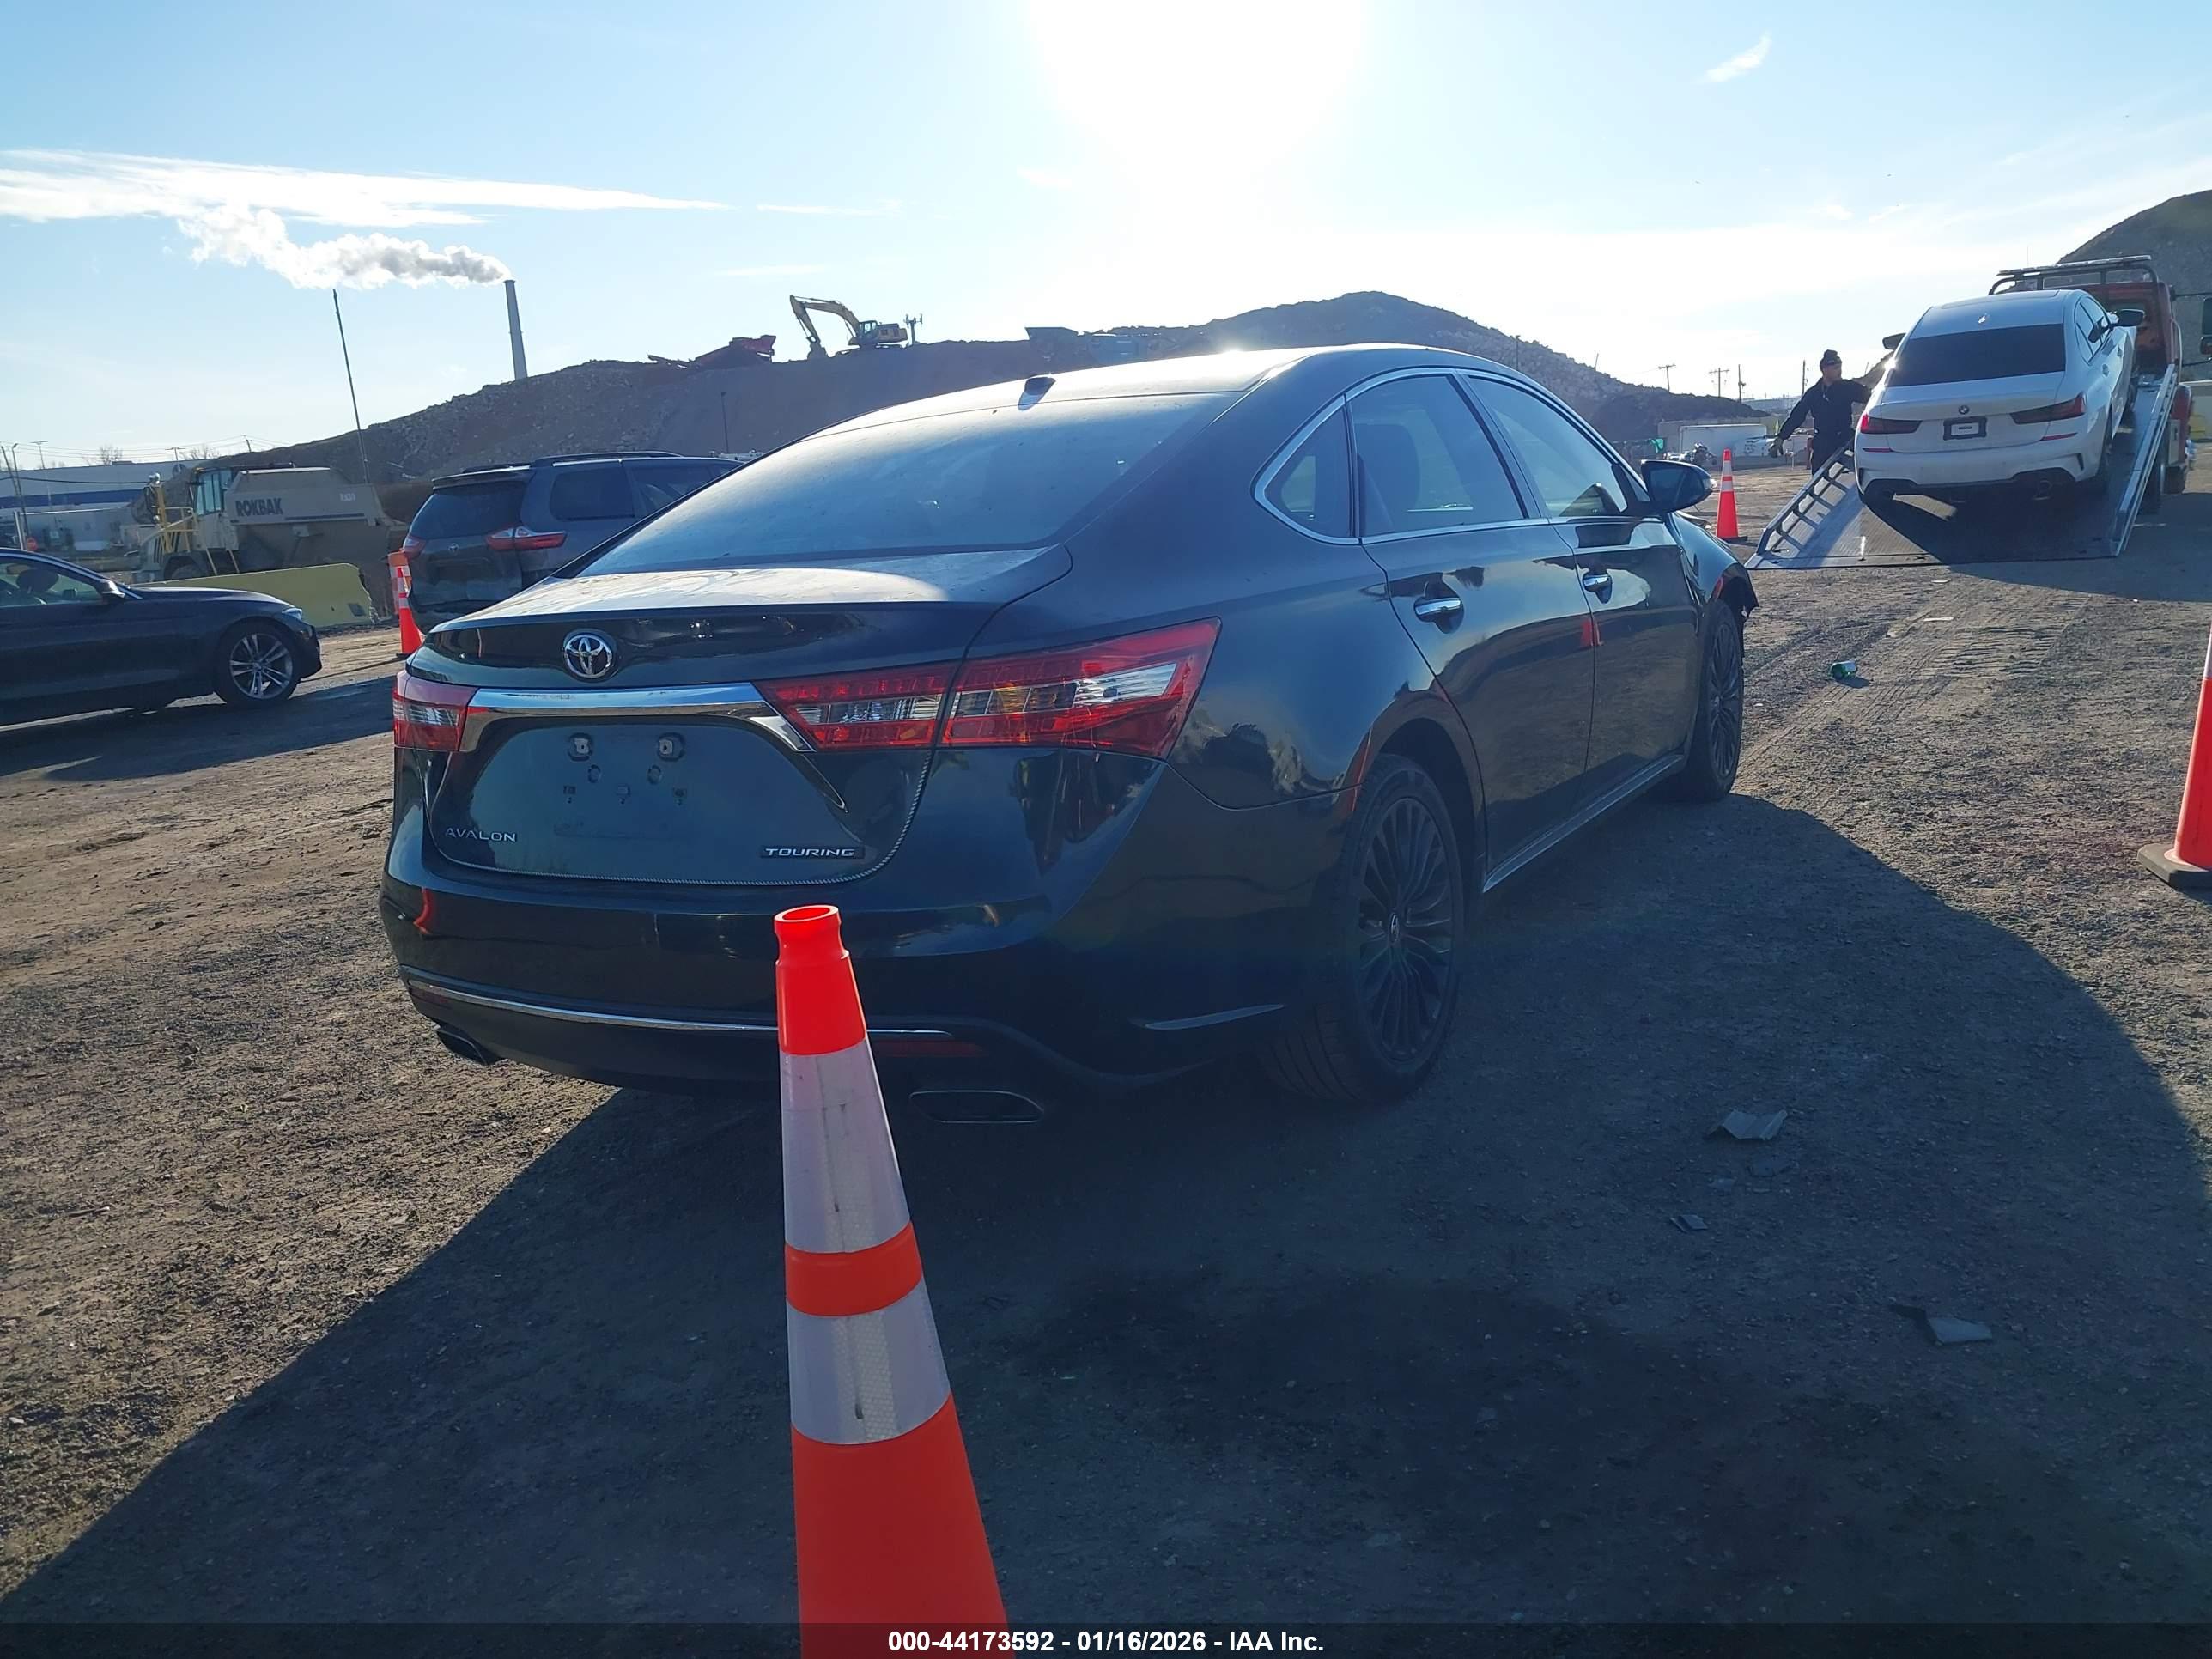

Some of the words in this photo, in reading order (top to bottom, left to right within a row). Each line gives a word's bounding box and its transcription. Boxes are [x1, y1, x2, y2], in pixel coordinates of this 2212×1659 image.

[235, 498, 283, 516] ROKBAK
[446, 827, 517, 842] AVALON
[765, 848, 855, 857] TOURING
